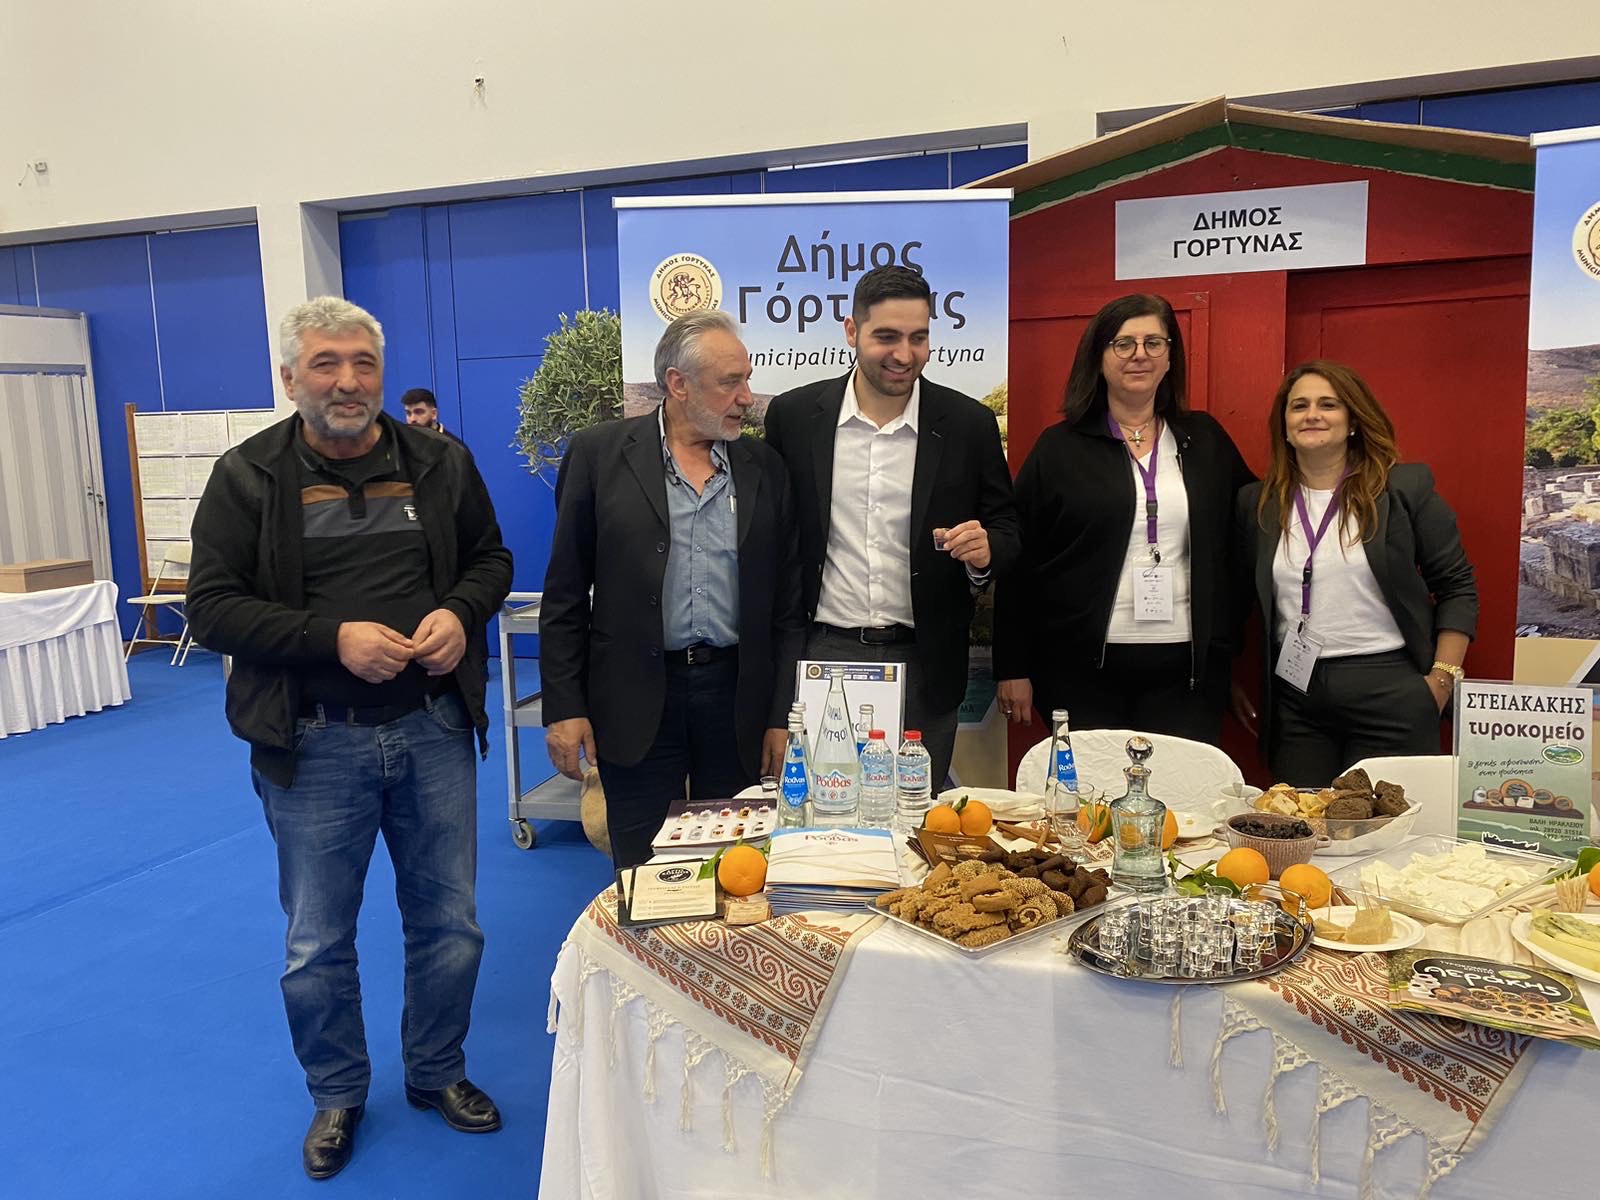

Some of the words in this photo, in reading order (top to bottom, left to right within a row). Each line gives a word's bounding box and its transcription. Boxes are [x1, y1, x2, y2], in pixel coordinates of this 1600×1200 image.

[1193, 207, 1282, 231] ΔΗΜΟΣ
[777, 231, 923, 282] Δήμος
[1173, 231, 1303, 259] ΓΟΡΤΥΝΑΣ
[653, 298, 675, 322] MUNICIP
[749, 347, 858, 370] nicipality
[927, 346, 985, 367] rtyna
[1467, 693, 1585, 715] ΣΤΕΙΑΚΑΚΗΣ
[1469, 721, 1585, 743] τυροκομείο
